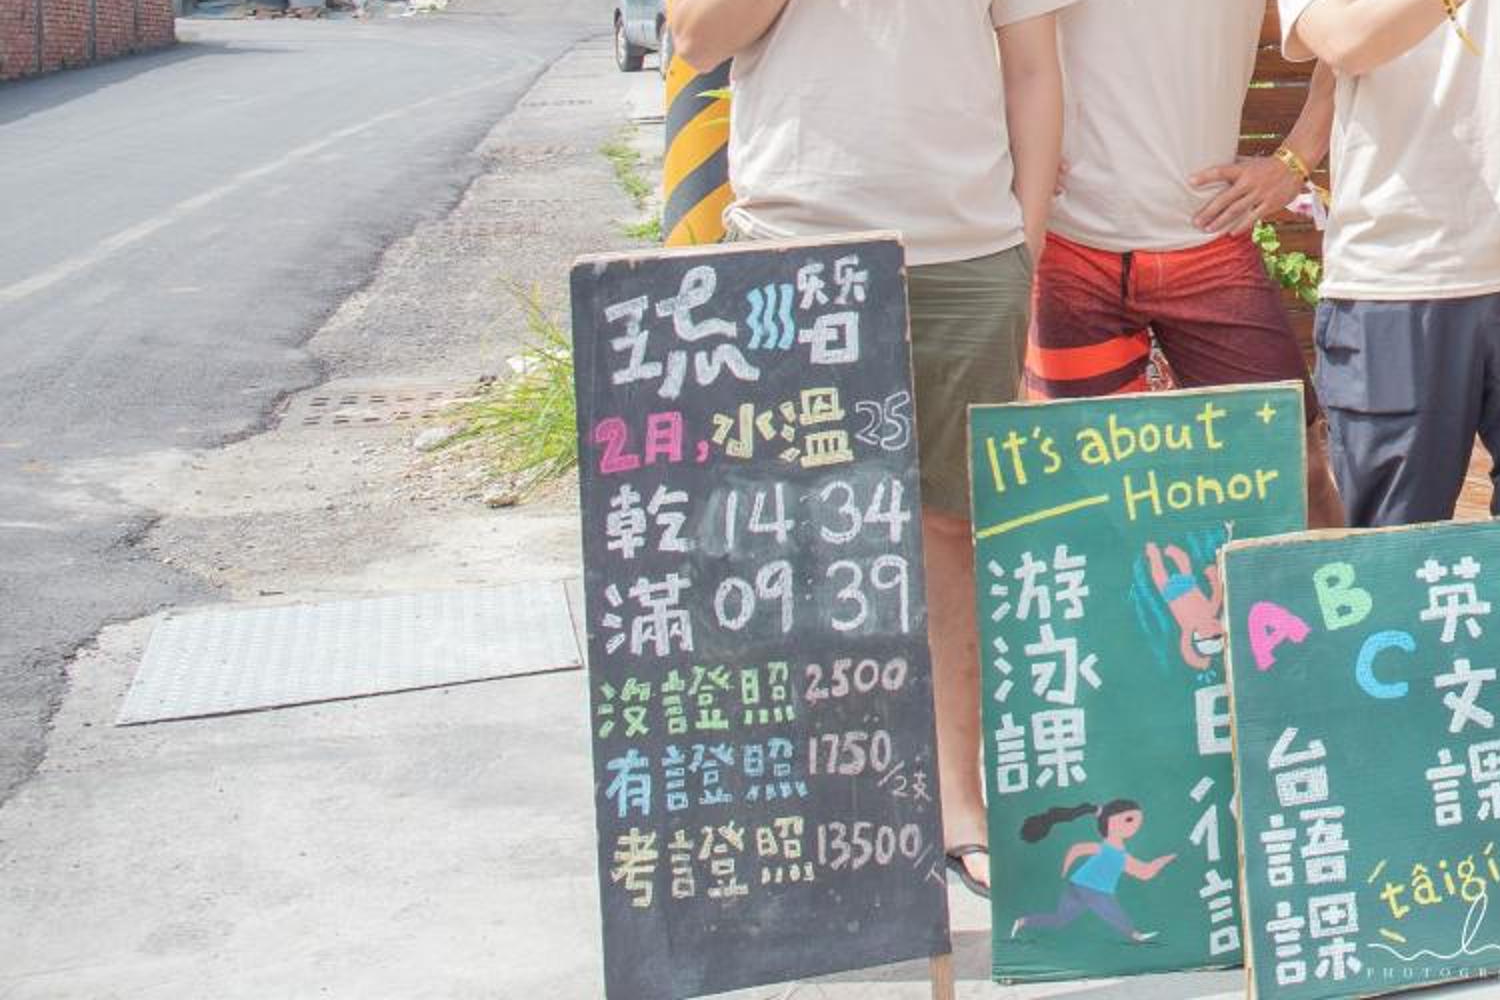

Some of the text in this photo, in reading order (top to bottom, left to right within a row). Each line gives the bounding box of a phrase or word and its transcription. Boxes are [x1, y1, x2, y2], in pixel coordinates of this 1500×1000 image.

[986, 402, 1227, 491] It's about
[1123, 468, 1279, 521] Honor
[988, 544, 1103, 794] 游泳課
[1259, 727, 1362, 985] 台語課
